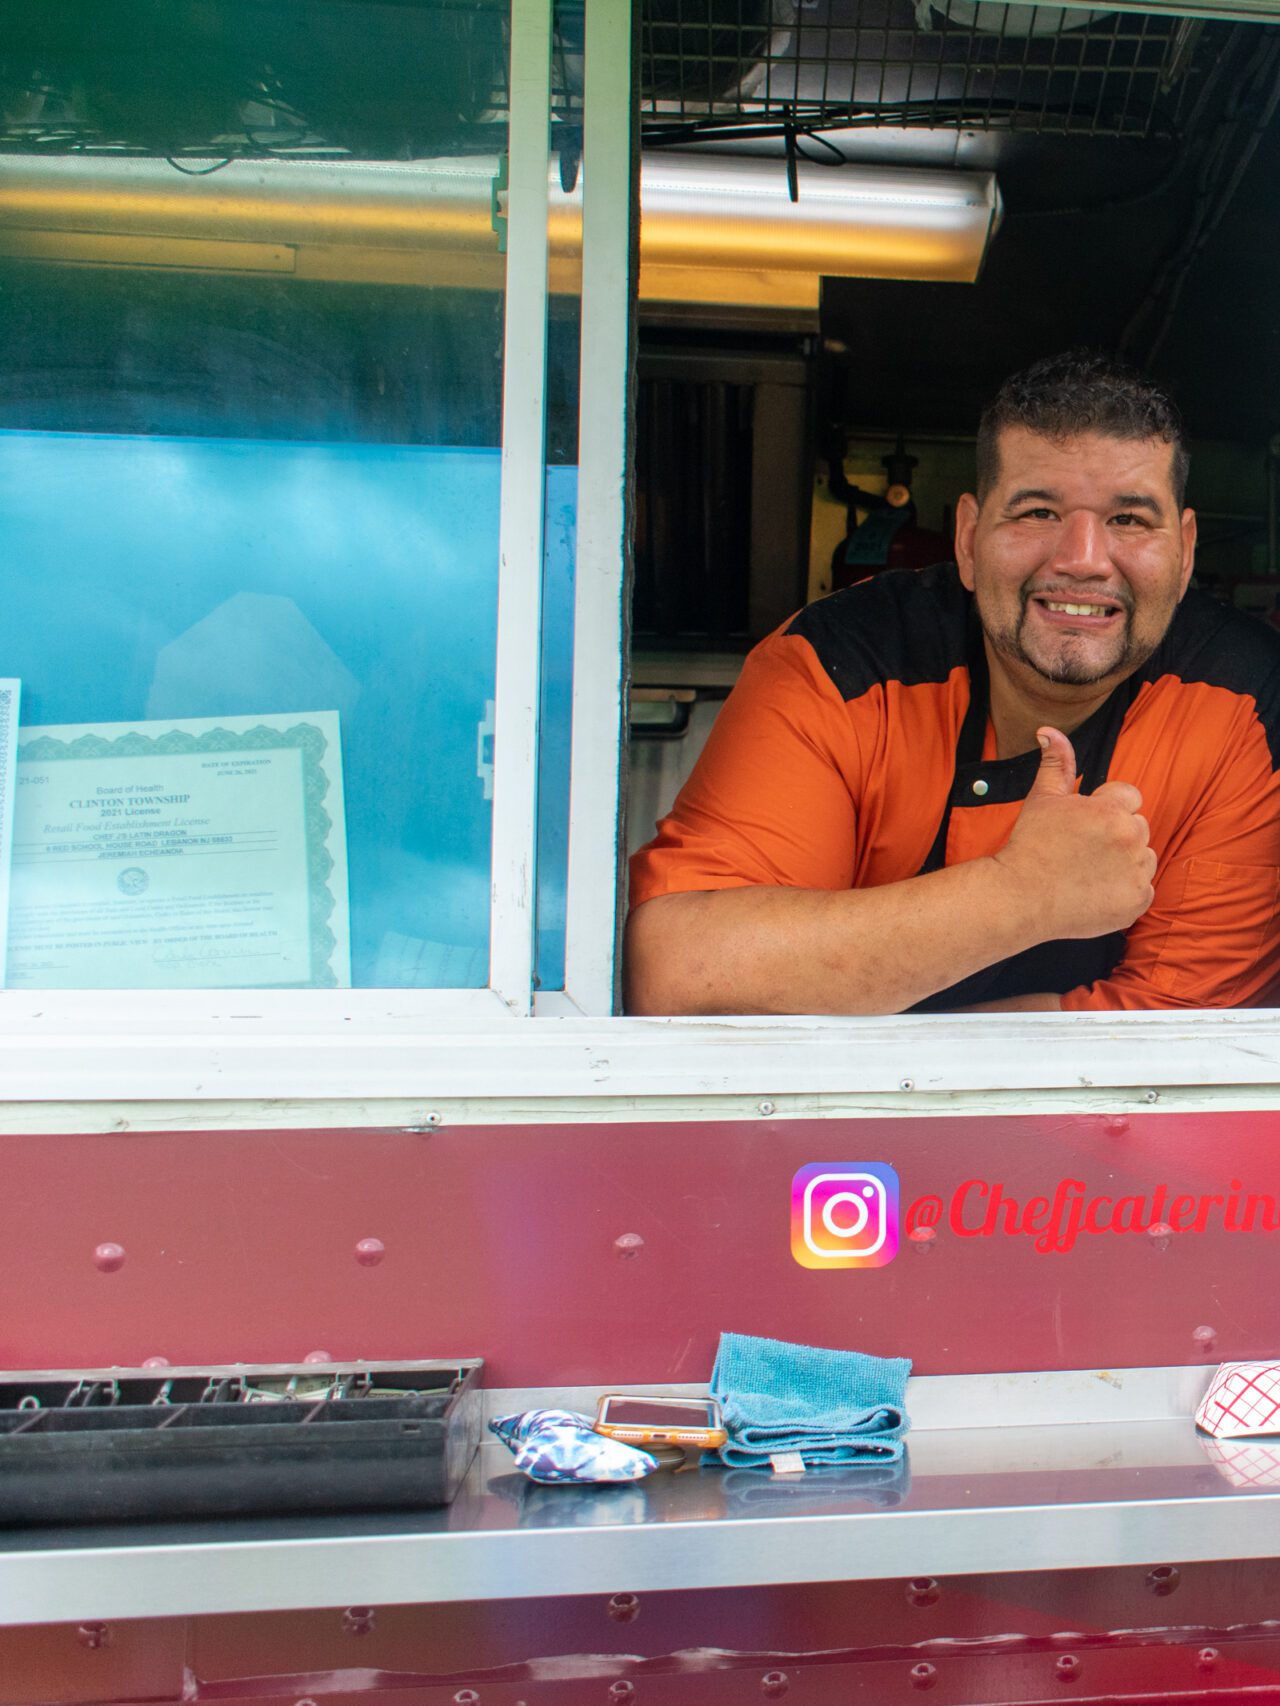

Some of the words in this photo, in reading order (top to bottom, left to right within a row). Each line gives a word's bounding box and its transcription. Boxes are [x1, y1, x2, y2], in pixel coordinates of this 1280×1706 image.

[69, 797, 125, 809] CLINTON
[128, 794, 191, 806] TOWNSHIP
[100, 809, 122, 817] 2021
[125, 808, 161, 816] License
